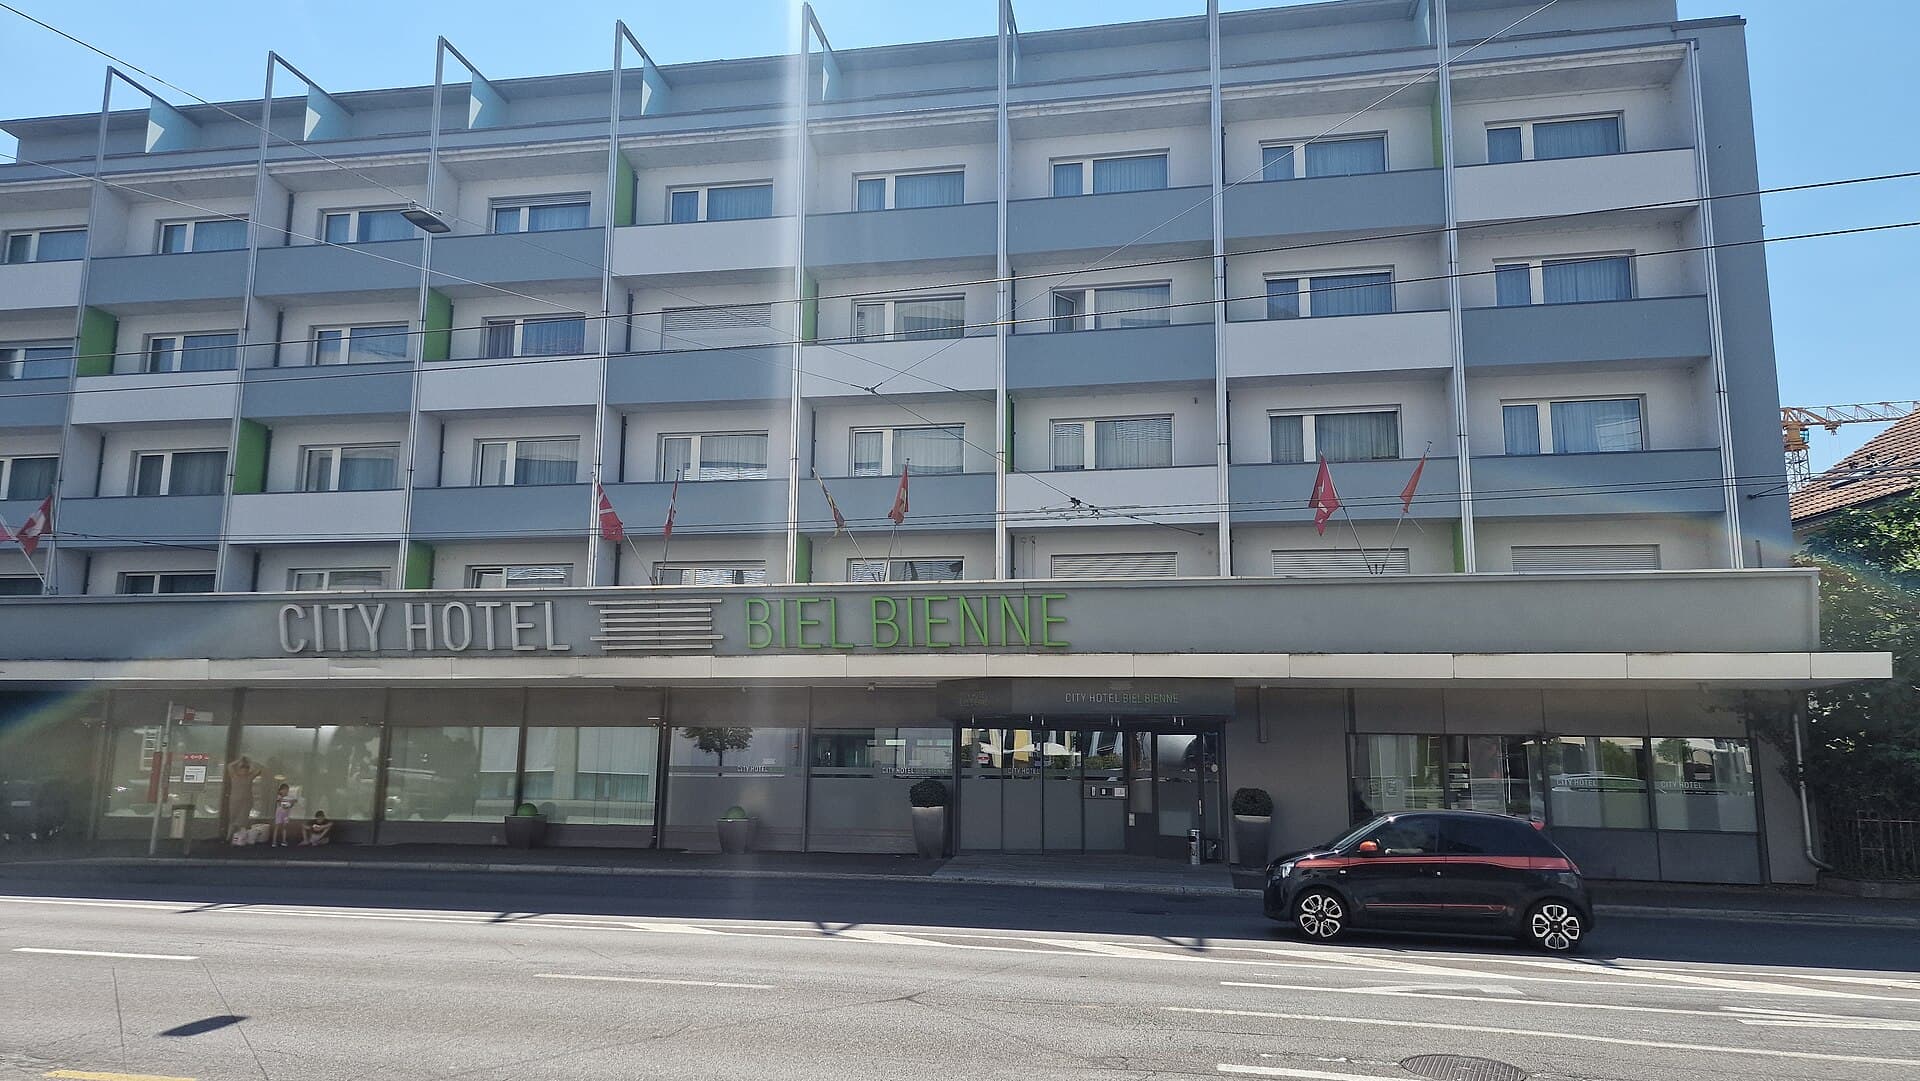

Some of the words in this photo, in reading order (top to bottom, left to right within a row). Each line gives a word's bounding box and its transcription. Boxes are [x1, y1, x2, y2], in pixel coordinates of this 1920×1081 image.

[278, 602, 386, 653] CITY
[404, 601, 570, 651] HOTEL
[745, 597, 854, 649] BIEL
[871, 593, 1070, 648] BIENNE
[1065, 693, 1086, 703] CITY
[1089, 693, 1120, 703] HOTEL
[1123, 694, 1142, 704] BIEL
[1144, 694, 1179, 704] BIENNE
